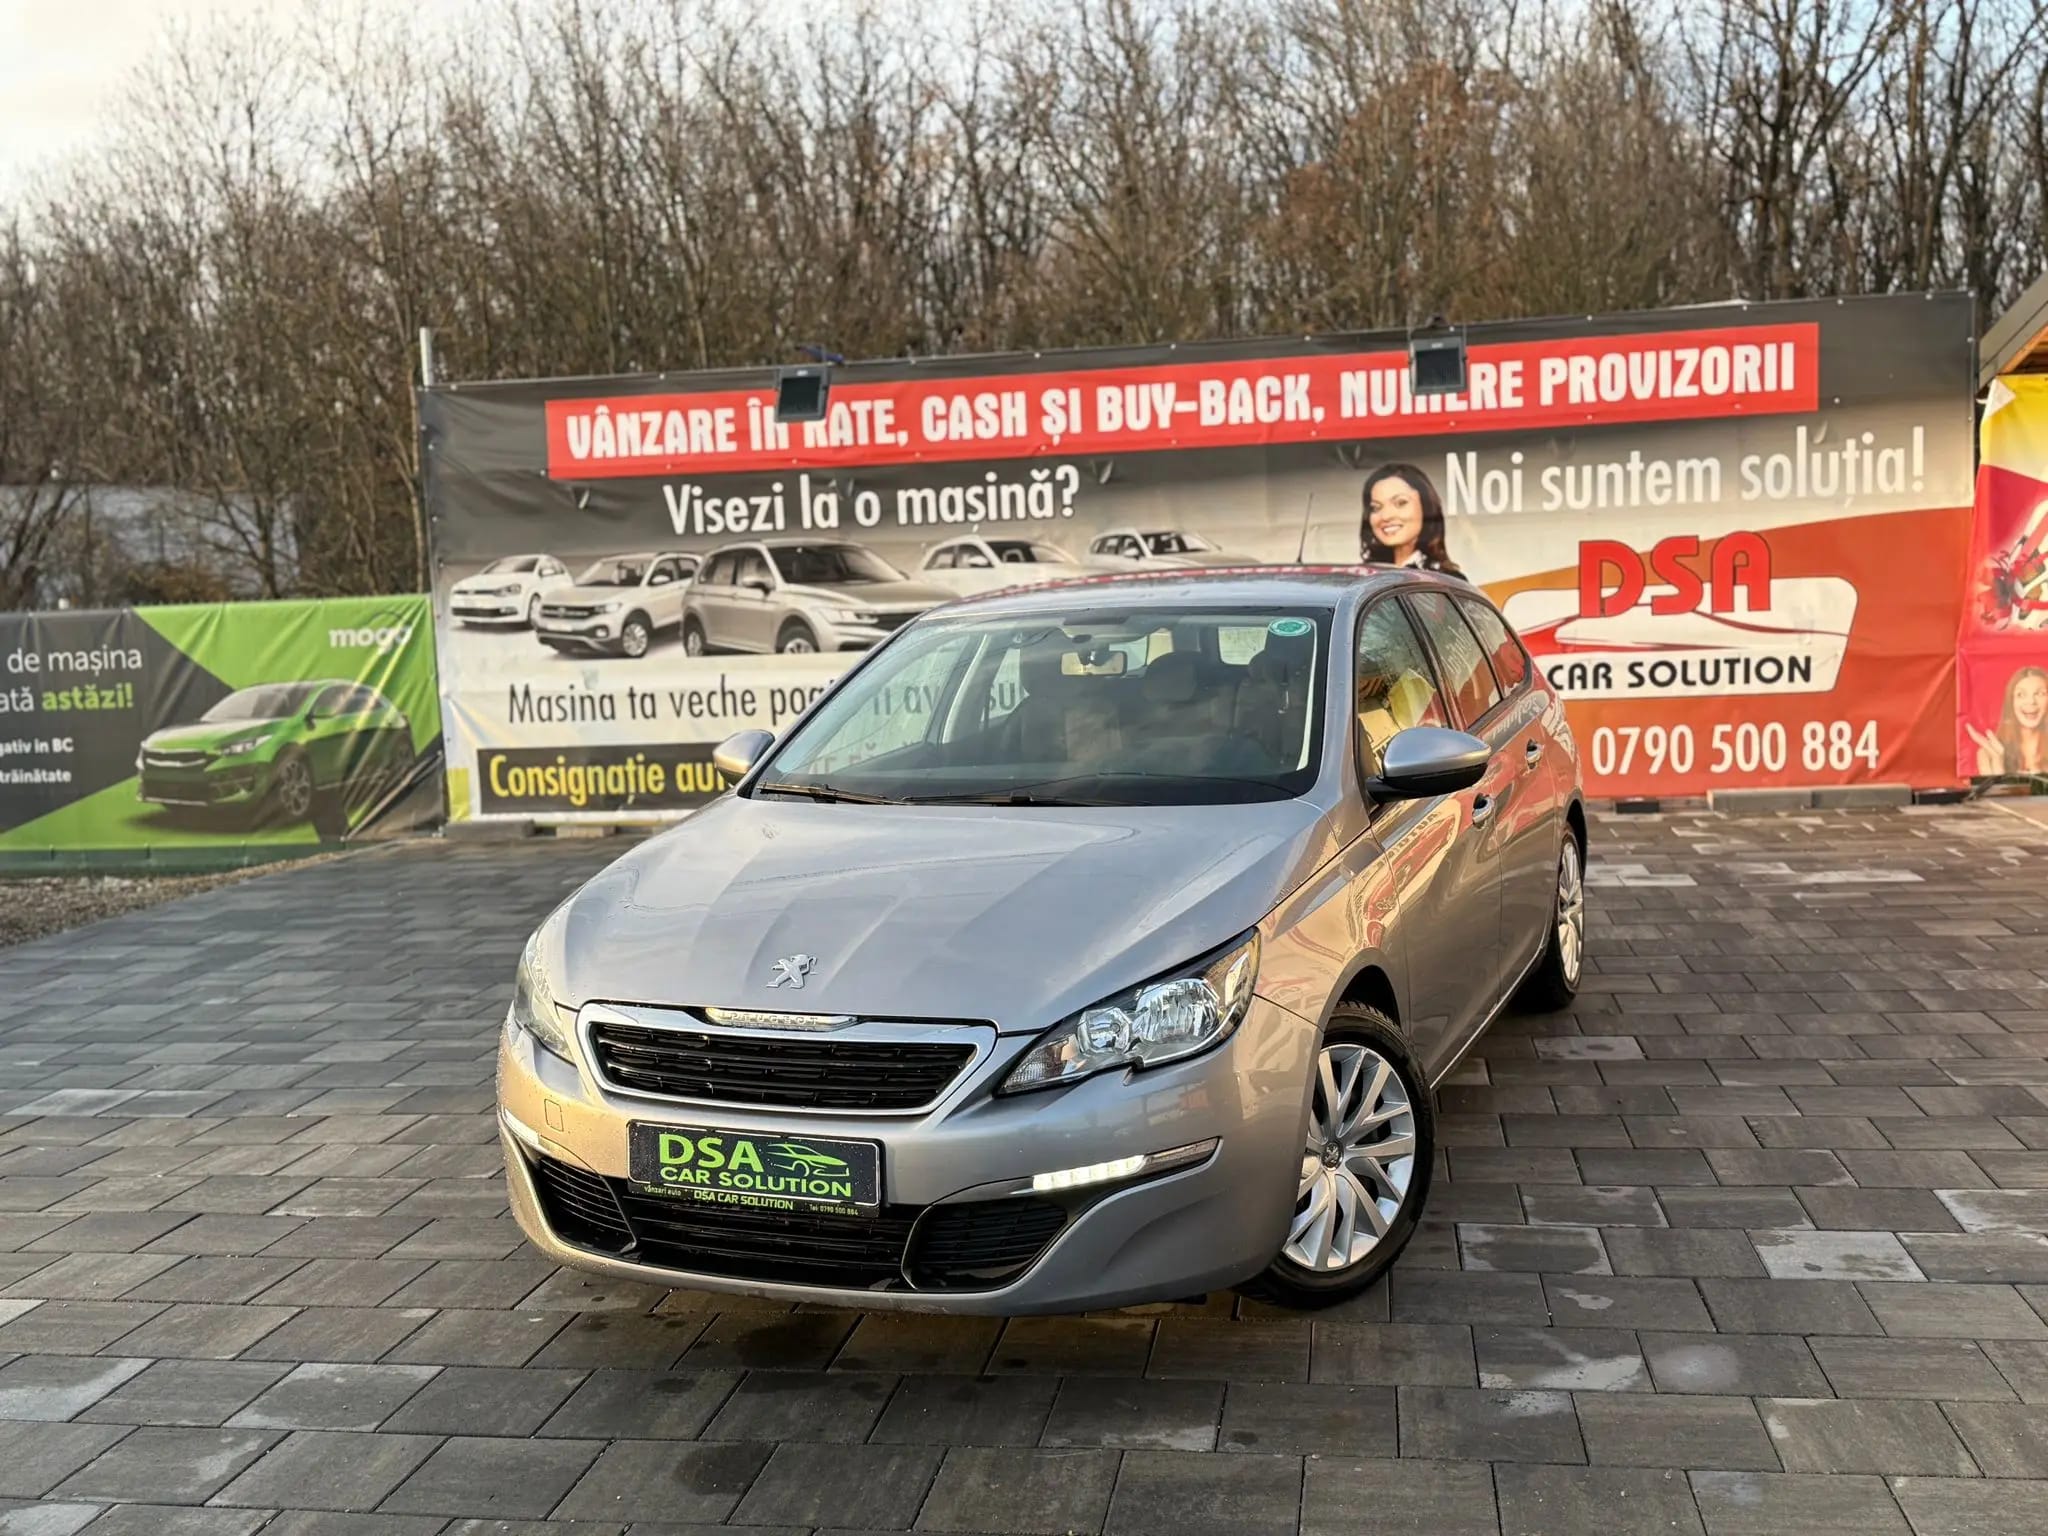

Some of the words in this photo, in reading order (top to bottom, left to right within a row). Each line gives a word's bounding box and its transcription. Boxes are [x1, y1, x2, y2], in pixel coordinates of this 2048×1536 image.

[566, 405, 737, 459] VÂNZARE
[803, 399, 908, 448] RATE,
[921, 389, 1027, 442] CASH
[1041, 388, 1082, 444] ȘI
[1540, 342, 1796, 405] PROVIZORII
[1445, 451, 1523, 516] Noi
[1540, 450, 1721, 512] suntem
[1739, 425, 1925, 508] soluția!
[662, 482, 786, 535] Visezi
[800, 473, 839, 529] la
[854, 490, 881, 527] o
[896, 464, 1080, 533] mașină?
[1578, 531, 1772, 618] DSA
[7, 647, 41, 673] de
[47, 644, 143, 677] mașina
[1547, 662, 1613, 690] CAR
[1627, 655, 1812, 688] SOLUTION
[41, 682, 135, 712] astăzi!
[508, 683, 616, 723] Masina
[627, 686, 657, 720] ta
[668, 673, 757, 718] veche
[52, 737, 74, 753] BC
[1592, 724, 1694, 776] 0790
[1709, 722, 1787, 774] 500
[1802, 719, 1880, 771] 884
[488, 752, 666, 807] Consignație
[658, 1132, 765, 1173] DSA
[660, 1166, 712, 1185] CAR
[718, 1172, 852, 1197] SOLUTION
[693, 1190, 716, 1202] DSA
[717, 1193, 739, 1205] CAR
[740, 1196, 794, 1210] SOLUTION
